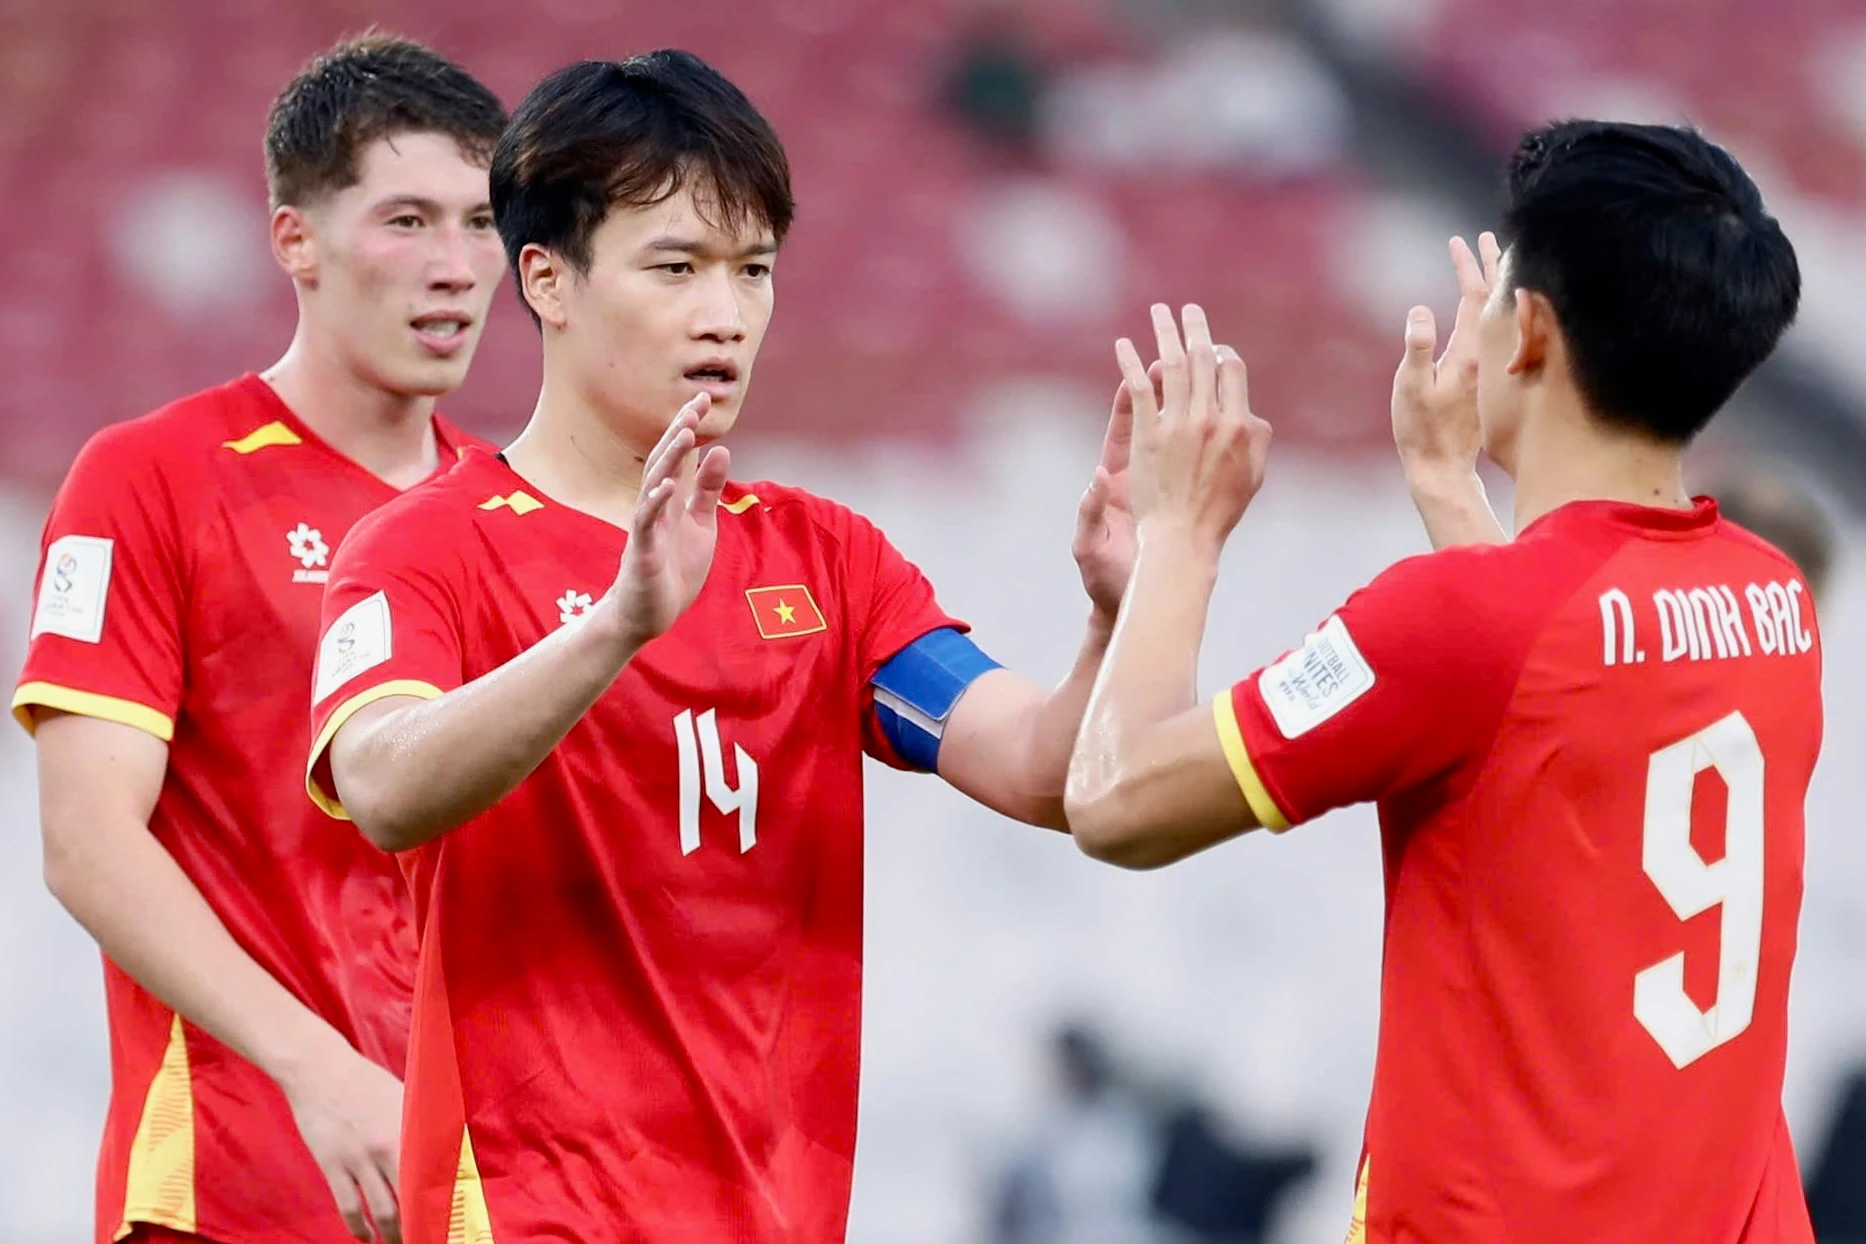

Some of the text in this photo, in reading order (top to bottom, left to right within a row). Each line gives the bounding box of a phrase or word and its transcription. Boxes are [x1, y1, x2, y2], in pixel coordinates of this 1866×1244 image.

[1315, 637, 1351, 685] OOTBALL
[1599, 578, 1812, 666] N. DINH BAC
[1301, 647, 1339, 697] NITES
[673, 707, 758, 857] 14
[1633, 710, 1765, 1070] 9
